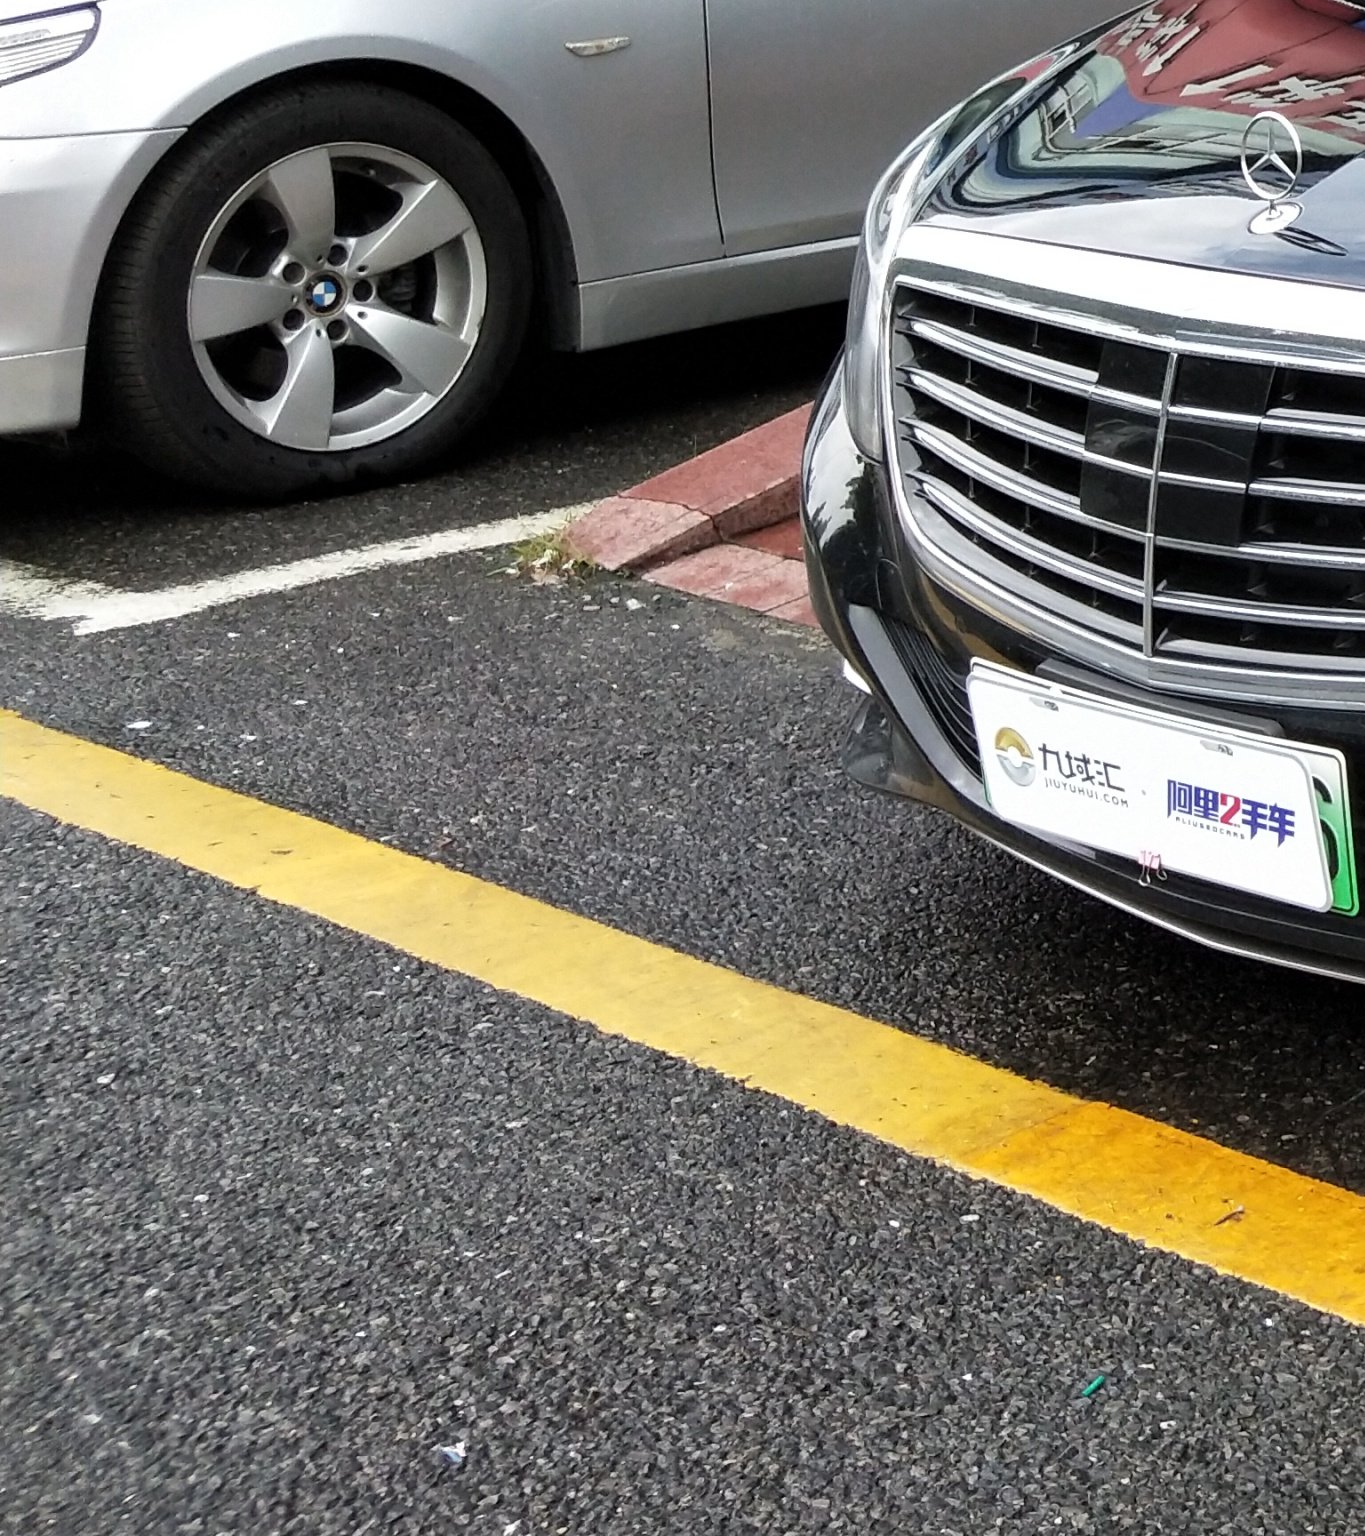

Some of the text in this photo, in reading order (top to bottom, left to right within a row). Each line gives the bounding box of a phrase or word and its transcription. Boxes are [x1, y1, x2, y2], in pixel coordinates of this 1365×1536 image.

[1037, 743, 1296, 848] 九域汇 阿里2手车
[1044, 776, 1130, 809] JIUYUHUI.COM
